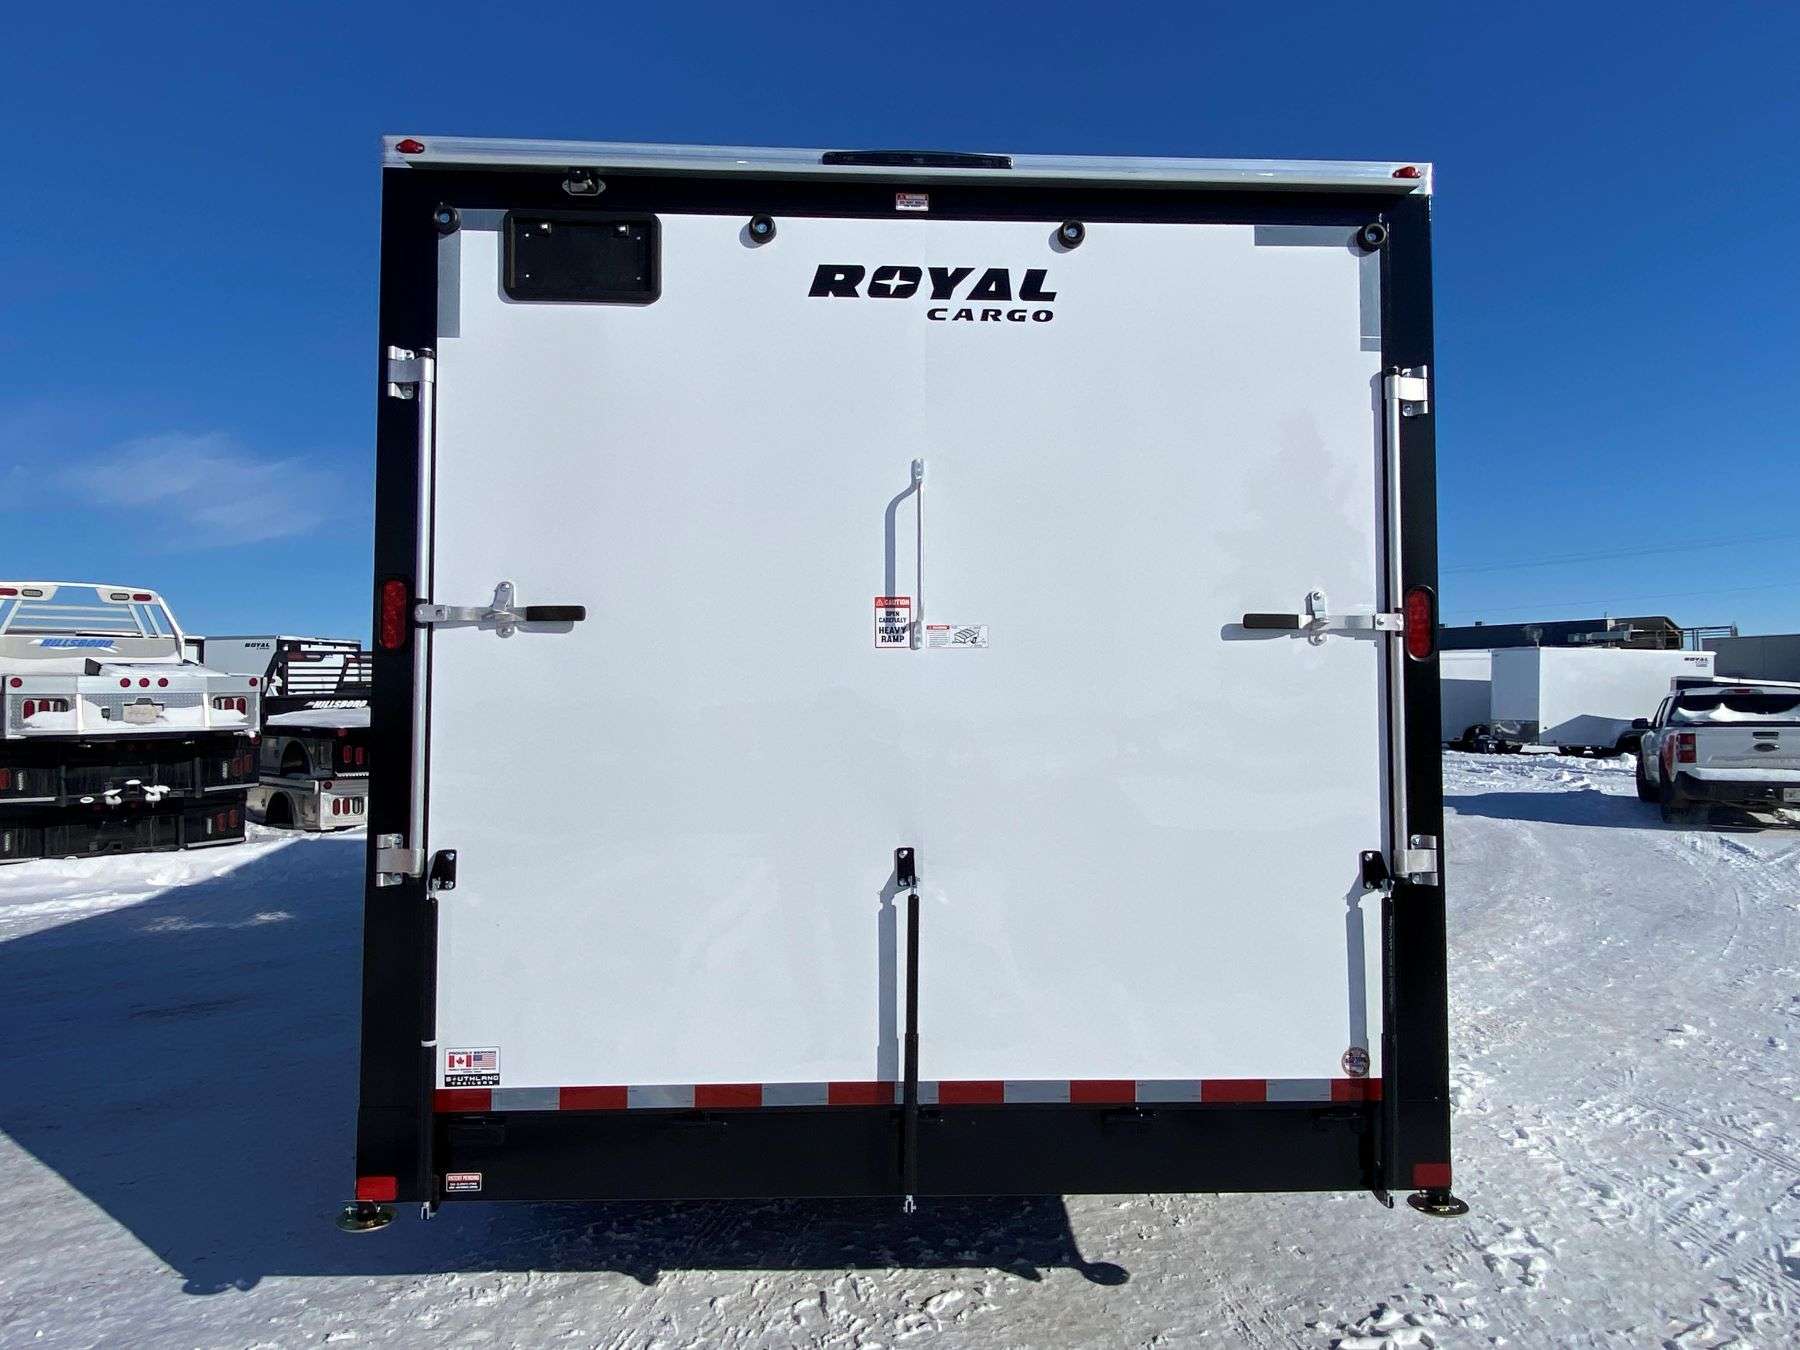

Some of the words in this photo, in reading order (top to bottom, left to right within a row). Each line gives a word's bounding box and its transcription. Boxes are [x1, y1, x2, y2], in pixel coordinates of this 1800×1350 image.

[808, 264, 1057, 302] ROYAL
[927, 308, 1054, 322] CARGO
[878, 626, 907, 635] HEAVY
[881, 635, 905, 643] RAMP
[312, 699, 368, 709] HILLSBORO
